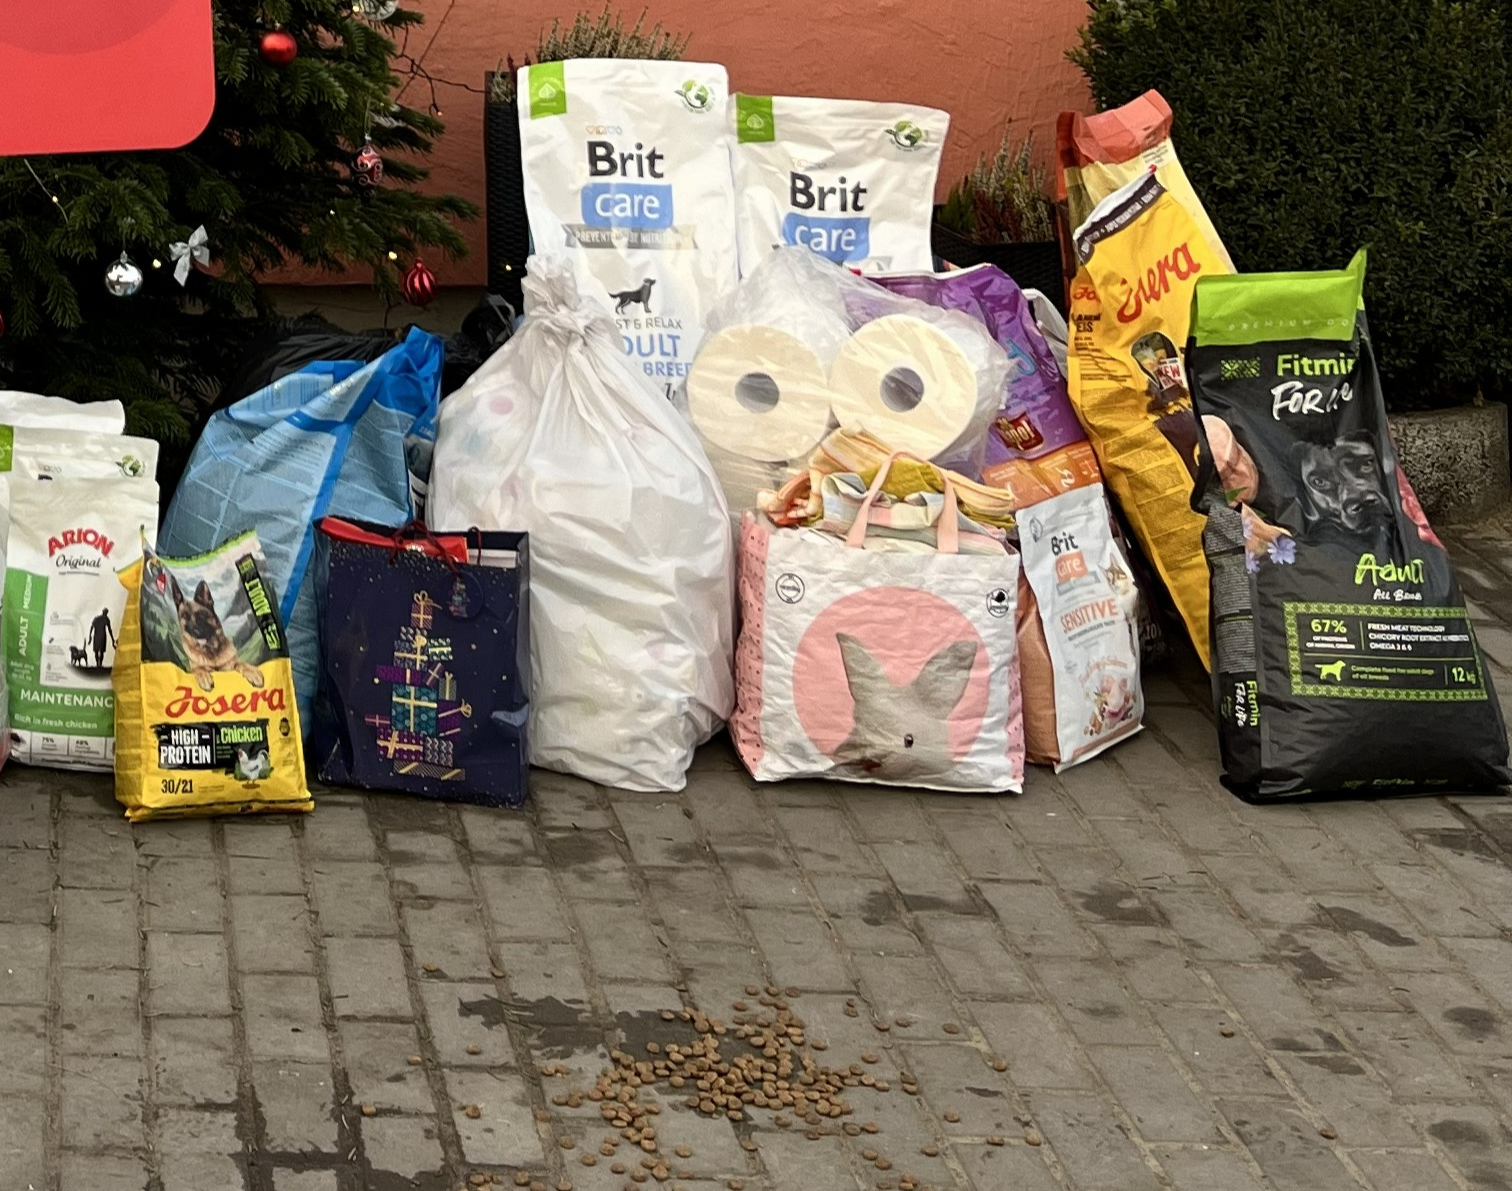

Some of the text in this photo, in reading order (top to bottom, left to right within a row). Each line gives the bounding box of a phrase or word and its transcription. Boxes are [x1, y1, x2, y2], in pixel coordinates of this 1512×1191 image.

[587, 140, 665, 179] Brit
[790, 171, 868, 213] Brit
[594, 193, 660, 220] care
[794, 223, 857, 252] care
[645, 316, 683, 330] RELAX
[48, 527, 115, 559] ARION
[55, 554, 101, 569] Original
[245, 578, 272, 617] ADULT
[1060, 598, 1119, 634] SENSITIVE
[1310, 618, 1348, 634] 67%
[18, 616, 29, 657] ADULT
[1451, 667, 1466, 683] 12
[165, 685, 286, 718] Josera
[1246, 680, 1260, 727] Fitmin
[14, 713, 31, 724] Rich
[42, 716, 64, 727] fresh
[65, 718, 98, 729] chicken
[220, 724, 263, 745] Chicken
[170, 728, 200, 746] HIGH
[160, 744, 211, 765] PROTEIN
[161, 778, 194, 795] 30/21
